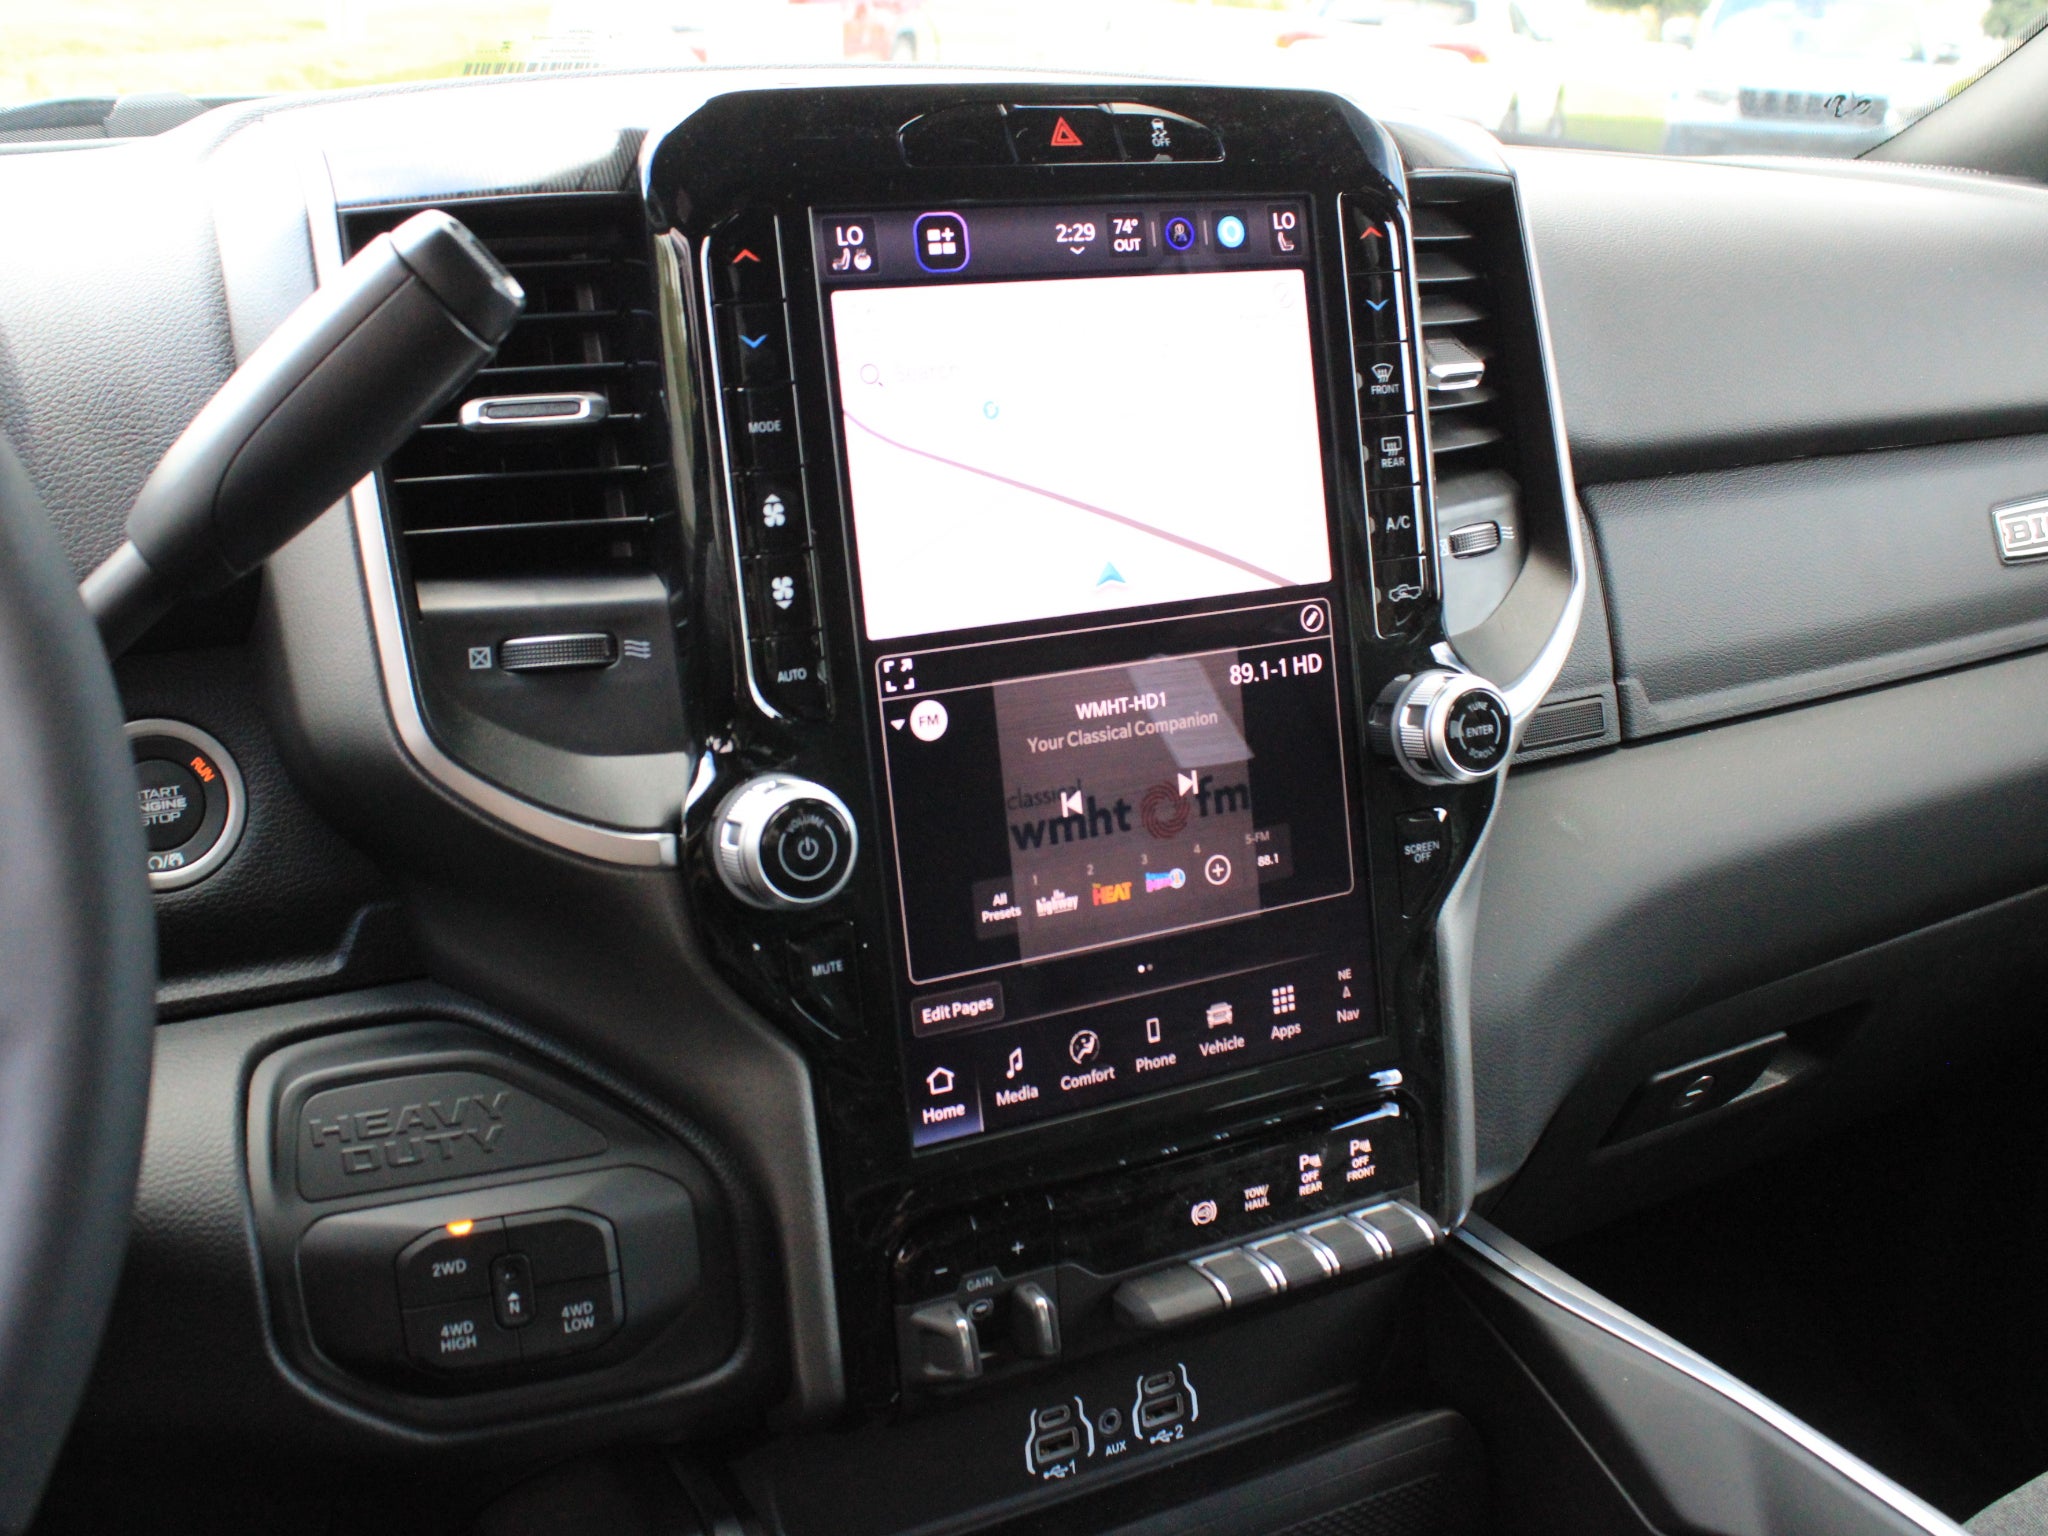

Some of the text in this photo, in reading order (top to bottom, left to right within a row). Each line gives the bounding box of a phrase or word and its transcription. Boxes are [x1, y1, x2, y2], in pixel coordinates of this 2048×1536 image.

[1152, 134, 1172, 147] OFF
[1271, 212, 1296, 230] LO
[834, 225, 864, 248] LO
[1055, 222, 1096, 244] 2:29
[1113, 236, 1142, 254] OUT
[1370, 383, 1400, 395] FRONT
[748, 419, 782, 434] MODE
[1380, 457, 1406, 469] REAR
[1385, 515, 1411, 533] A/C
[2001, 512, 2048, 548] BI
[777, 667, 807, 684] AUTO
[1229, 653, 1324, 687] 89.1-1 HD
[1074, 690, 1168, 721] WMHT-HD1
[917, 712, 942, 729] FM
[1027, 709, 1219, 755] Your Classical Companion
[1465, 723, 1495, 738] ENTER
[189, 756, 216, 783] RUN
[140, 797, 188, 813] NGINE
[1010, 774, 1251, 850] wmht fm
[1404, 840, 1440, 856] SCREEN
[1257, 853, 1280, 867] 88.1
[1414, 852, 1432, 864] OFF
[1087, 865, 1095, 876] 2
[1032, 874, 1039, 886] 1
[992, 892, 1008, 907] All
[981, 905, 1022, 923] Presets
[811, 959, 844, 977] MUTE
[1337, 968, 1353, 981] NE
[922, 996, 994, 1025] Edit Pages
[1336, 1006, 1360, 1024] Nav
[1270, 1022, 1301, 1042] Apps
[1199, 1034, 1245, 1058] Vehicle
[1135, 1051, 1177, 1074] Phone
[1060, 1066, 1116, 1092] Comfort
[996, 1084, 1039, 1107] Media
[308, 1090, 510, 1148] HEAVY
[922, 1102, 966, 1125] Home
[340, 1123, 506, 1176] DUTY
[1351, 1155, 1370, 1169] OFF
[1301, 1170, 1320, 1184] OFF
[1346, 1165, 1376, 1182] FRONT
[1243, 1183, 1270, 1201] TOW/
[1298, 1181, 1323, 1197] REAR
[1244, 1197, 1271, 1212] HAUL
[431, 1258, 468, 1278] 2WD
[966, 1274, 994, 1293] GAIN
[508, 1301, 521, 1315] N
[561, 1301, 594, 1319] 4WD
[440, 1320, 475, 1338] 4WD
[563, 1315, 595, 1334] LOW
[440, 1335, 478, 1353] HIGH
[1175, 1425, 1184, 1439] 2
[1105, 1440, 1127, 1457] AUX
[1068, 1460, 1077, 1474] 1
